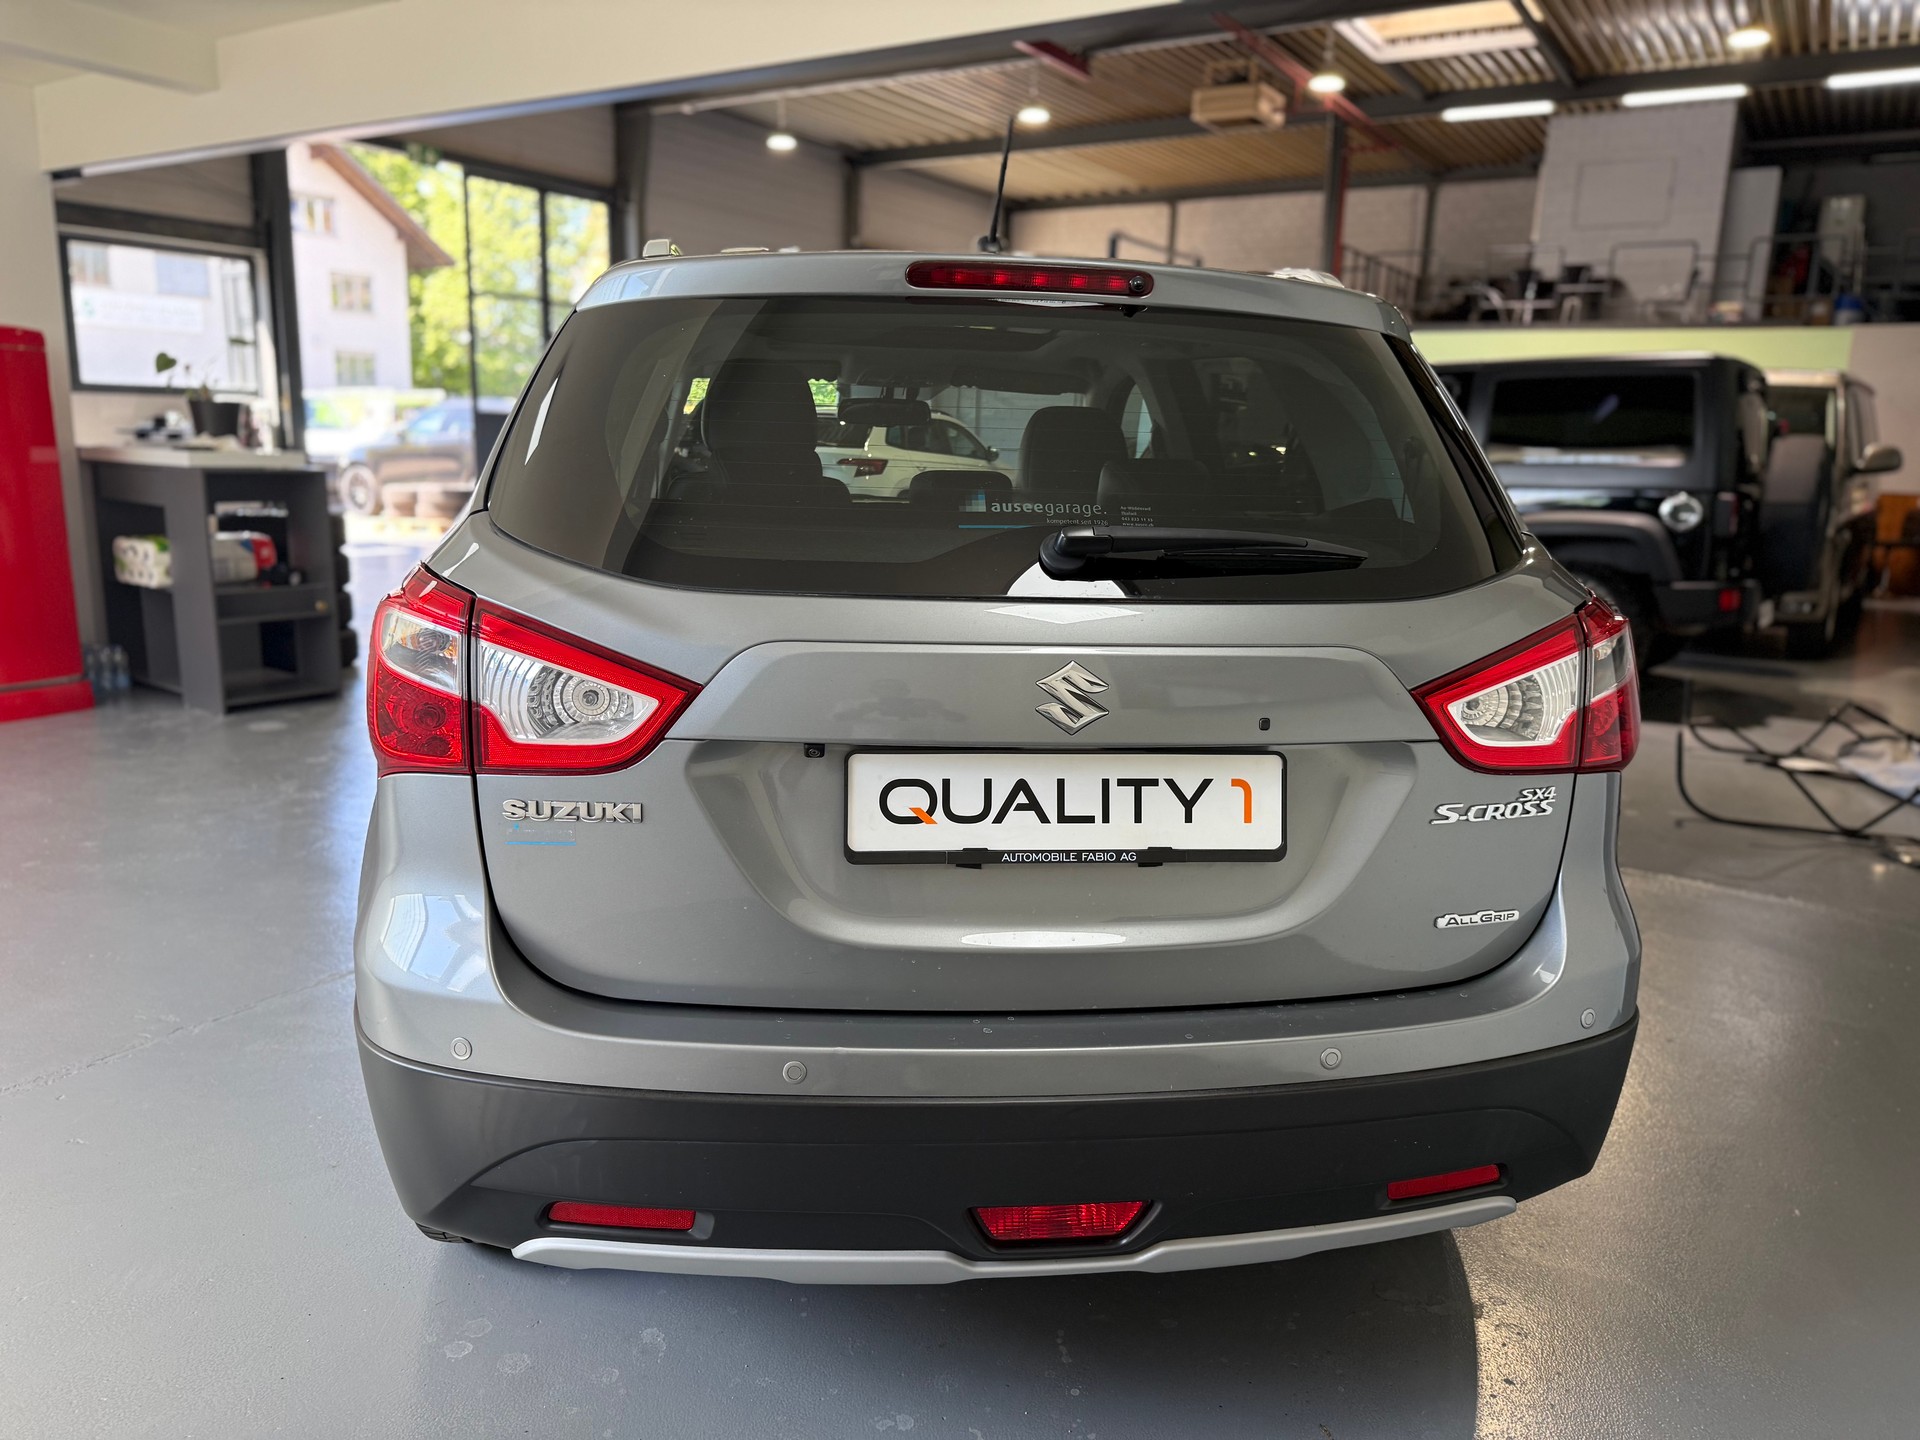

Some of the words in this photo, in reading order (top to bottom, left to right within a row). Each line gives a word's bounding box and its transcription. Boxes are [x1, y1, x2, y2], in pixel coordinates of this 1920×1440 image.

[1046, 518, 1079, 526] kompetent
[879, 778, 1214, 825] QUALITY
[1230, 778, 1253, 824] 1
[1517, 786, 1557, 801] SX4
[502, 799, 643, 823] SUZUKI
[1429, 799, 1556, 825] S-CROSS
[1001, 852, 1077, 863] AUTOMOBILE
[1082, 852, 1116, 862] FABIO
[1120, 852, 1137, 862] AG
